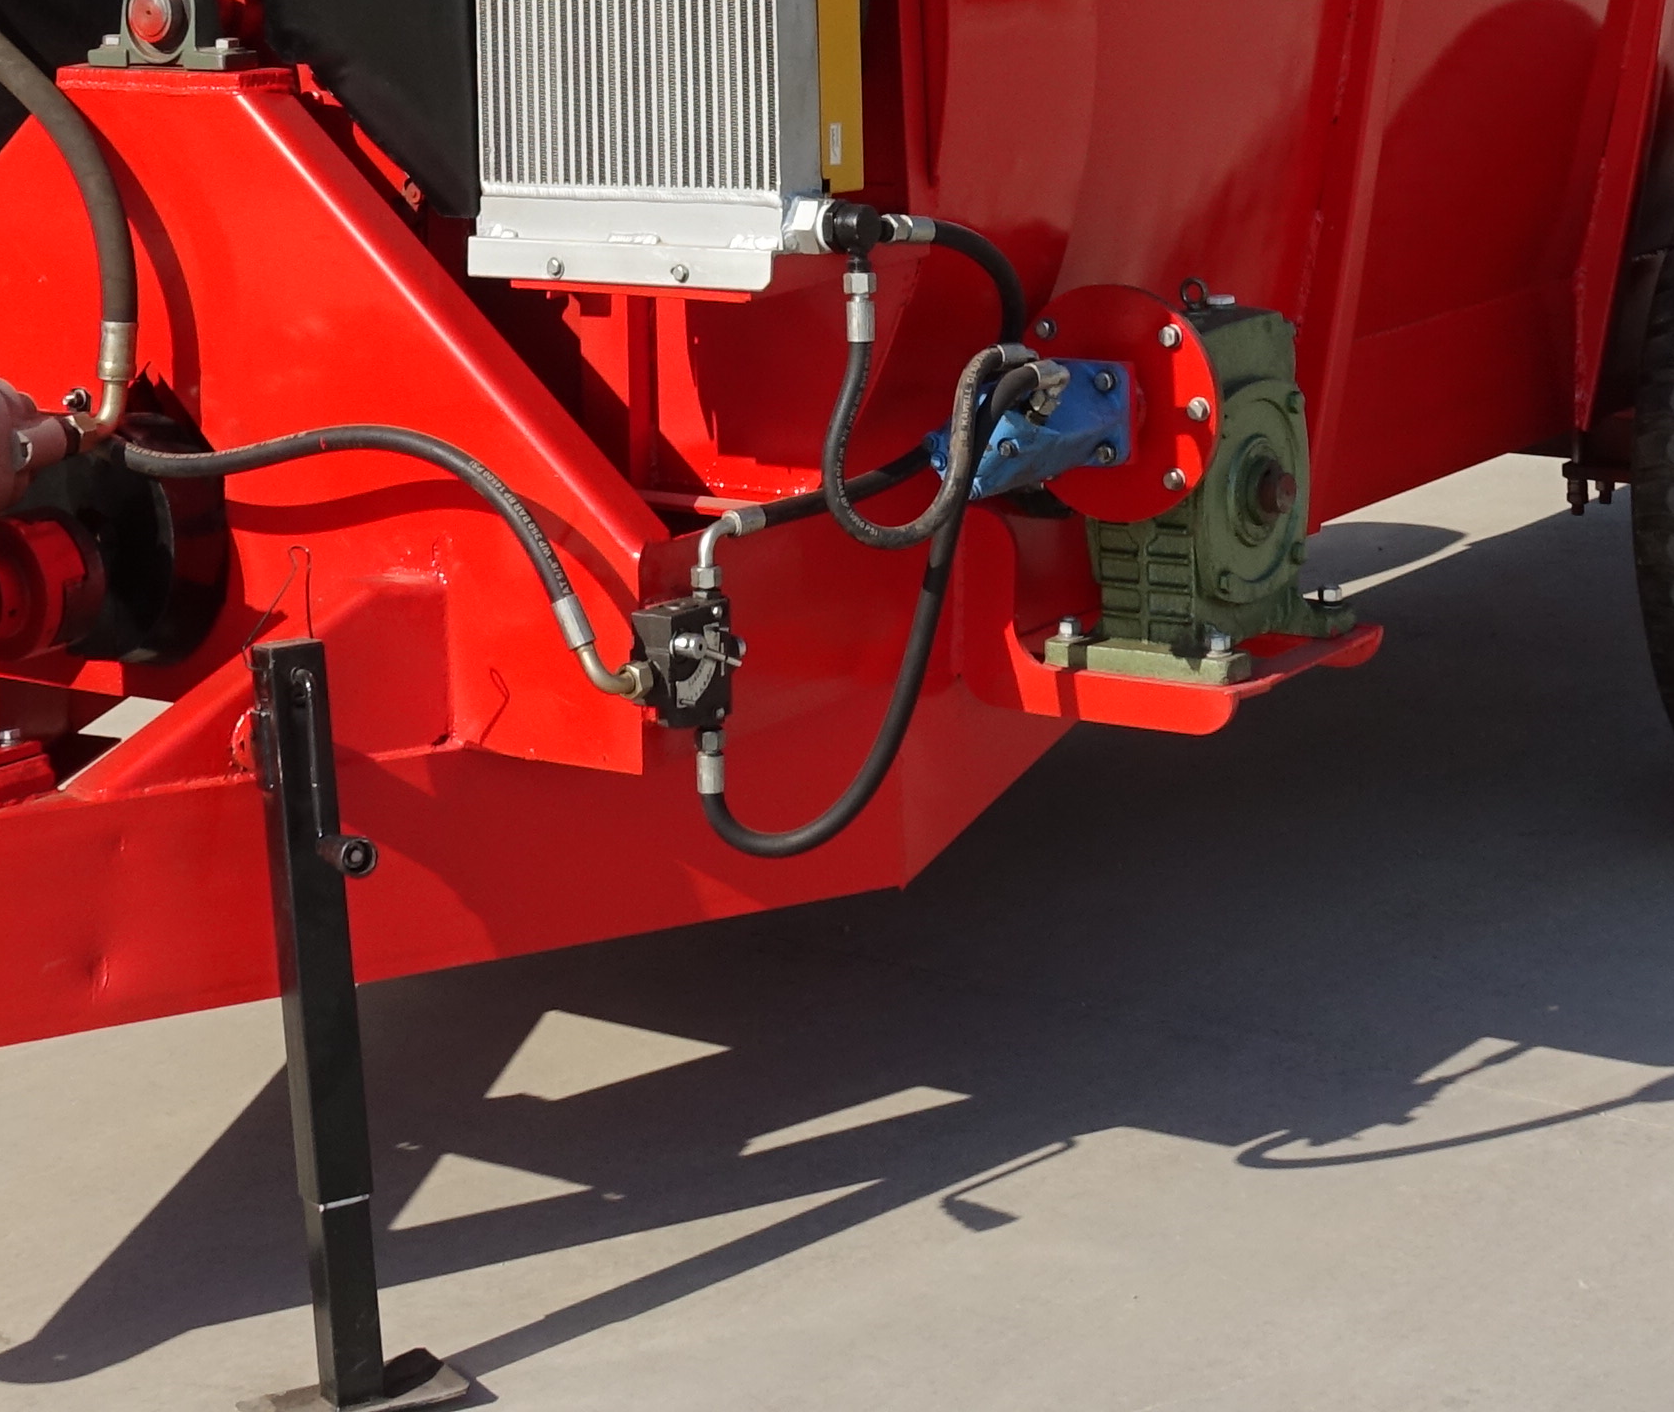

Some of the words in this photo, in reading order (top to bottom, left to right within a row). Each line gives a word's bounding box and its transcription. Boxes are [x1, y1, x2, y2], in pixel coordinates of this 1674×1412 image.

[469, 459, 485, 472] PSI
[511, 501, 533, 524] BAR
[863, 521, 880, 537] PSI
[536, 540, 553, 558] WP
